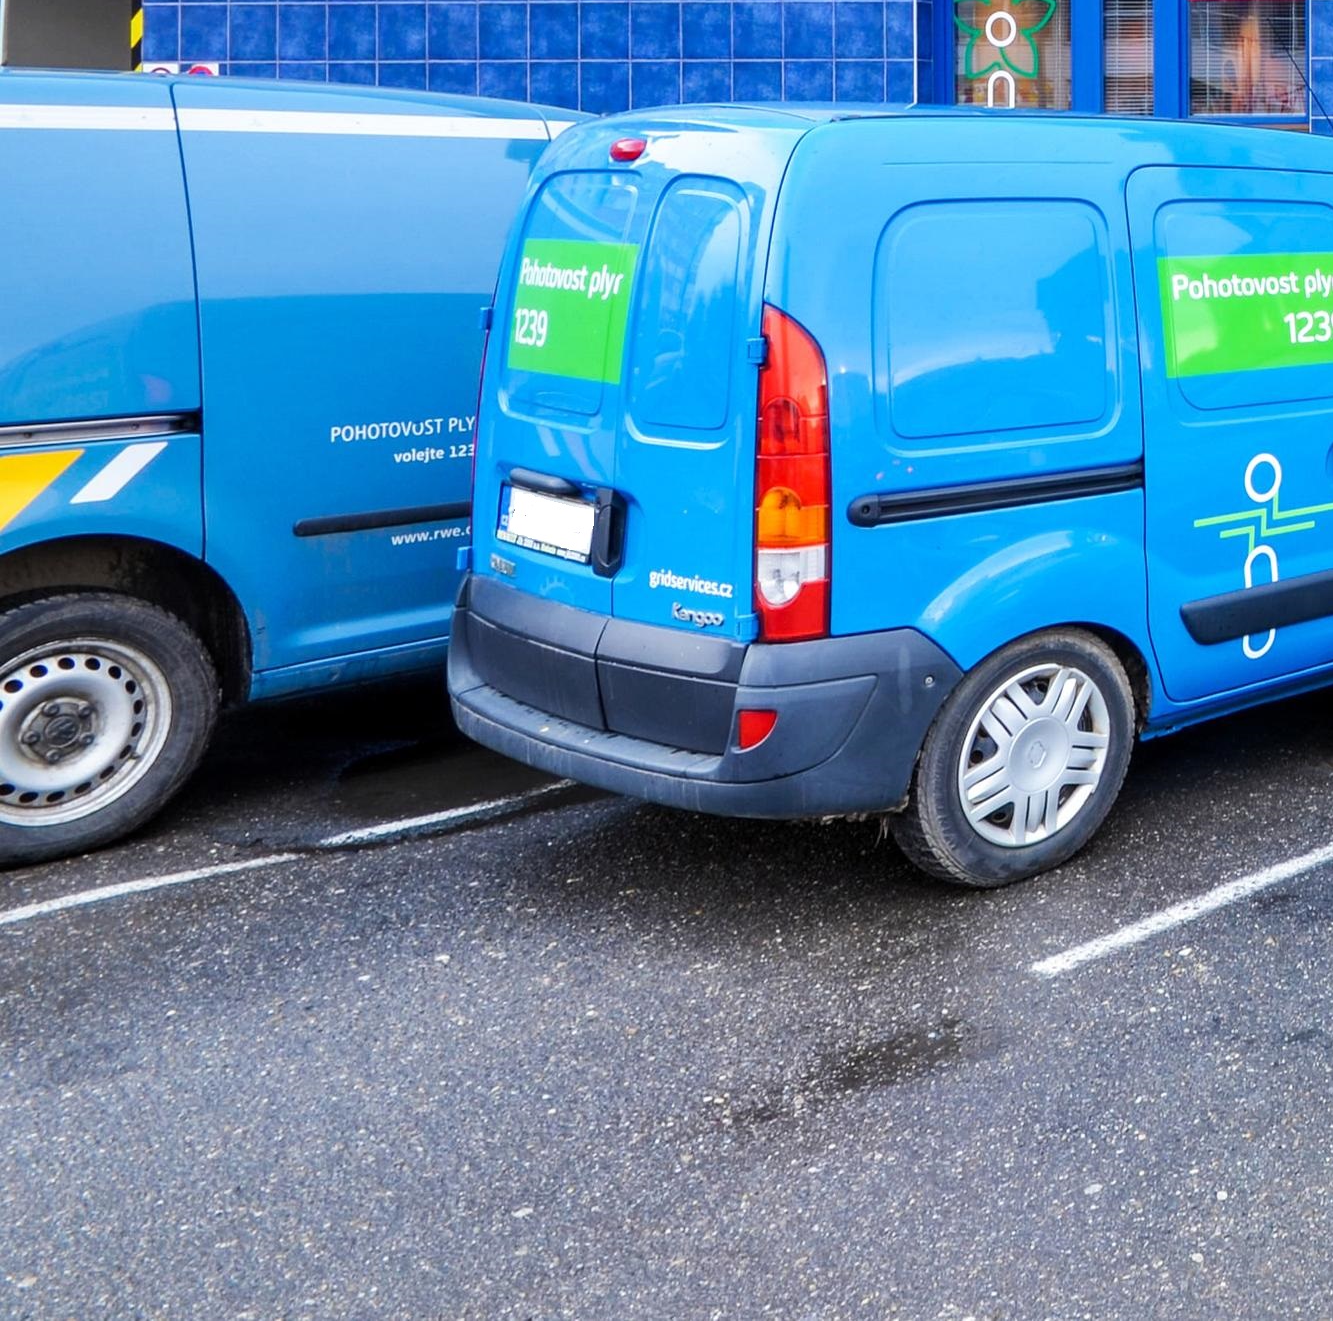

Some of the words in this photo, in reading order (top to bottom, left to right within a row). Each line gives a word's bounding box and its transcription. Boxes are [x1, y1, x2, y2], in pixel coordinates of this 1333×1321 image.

[519, 256, 589, 292] Pohotovost
[1170, 270, 1301, 301] Pohotovost
[514, 307, 549, 348] 1239
[330, 417, 444, 444] POHOTOVOST
[394, 447, 446, 464] volejte
[649, 569, 733, 598] gridservices.cz
